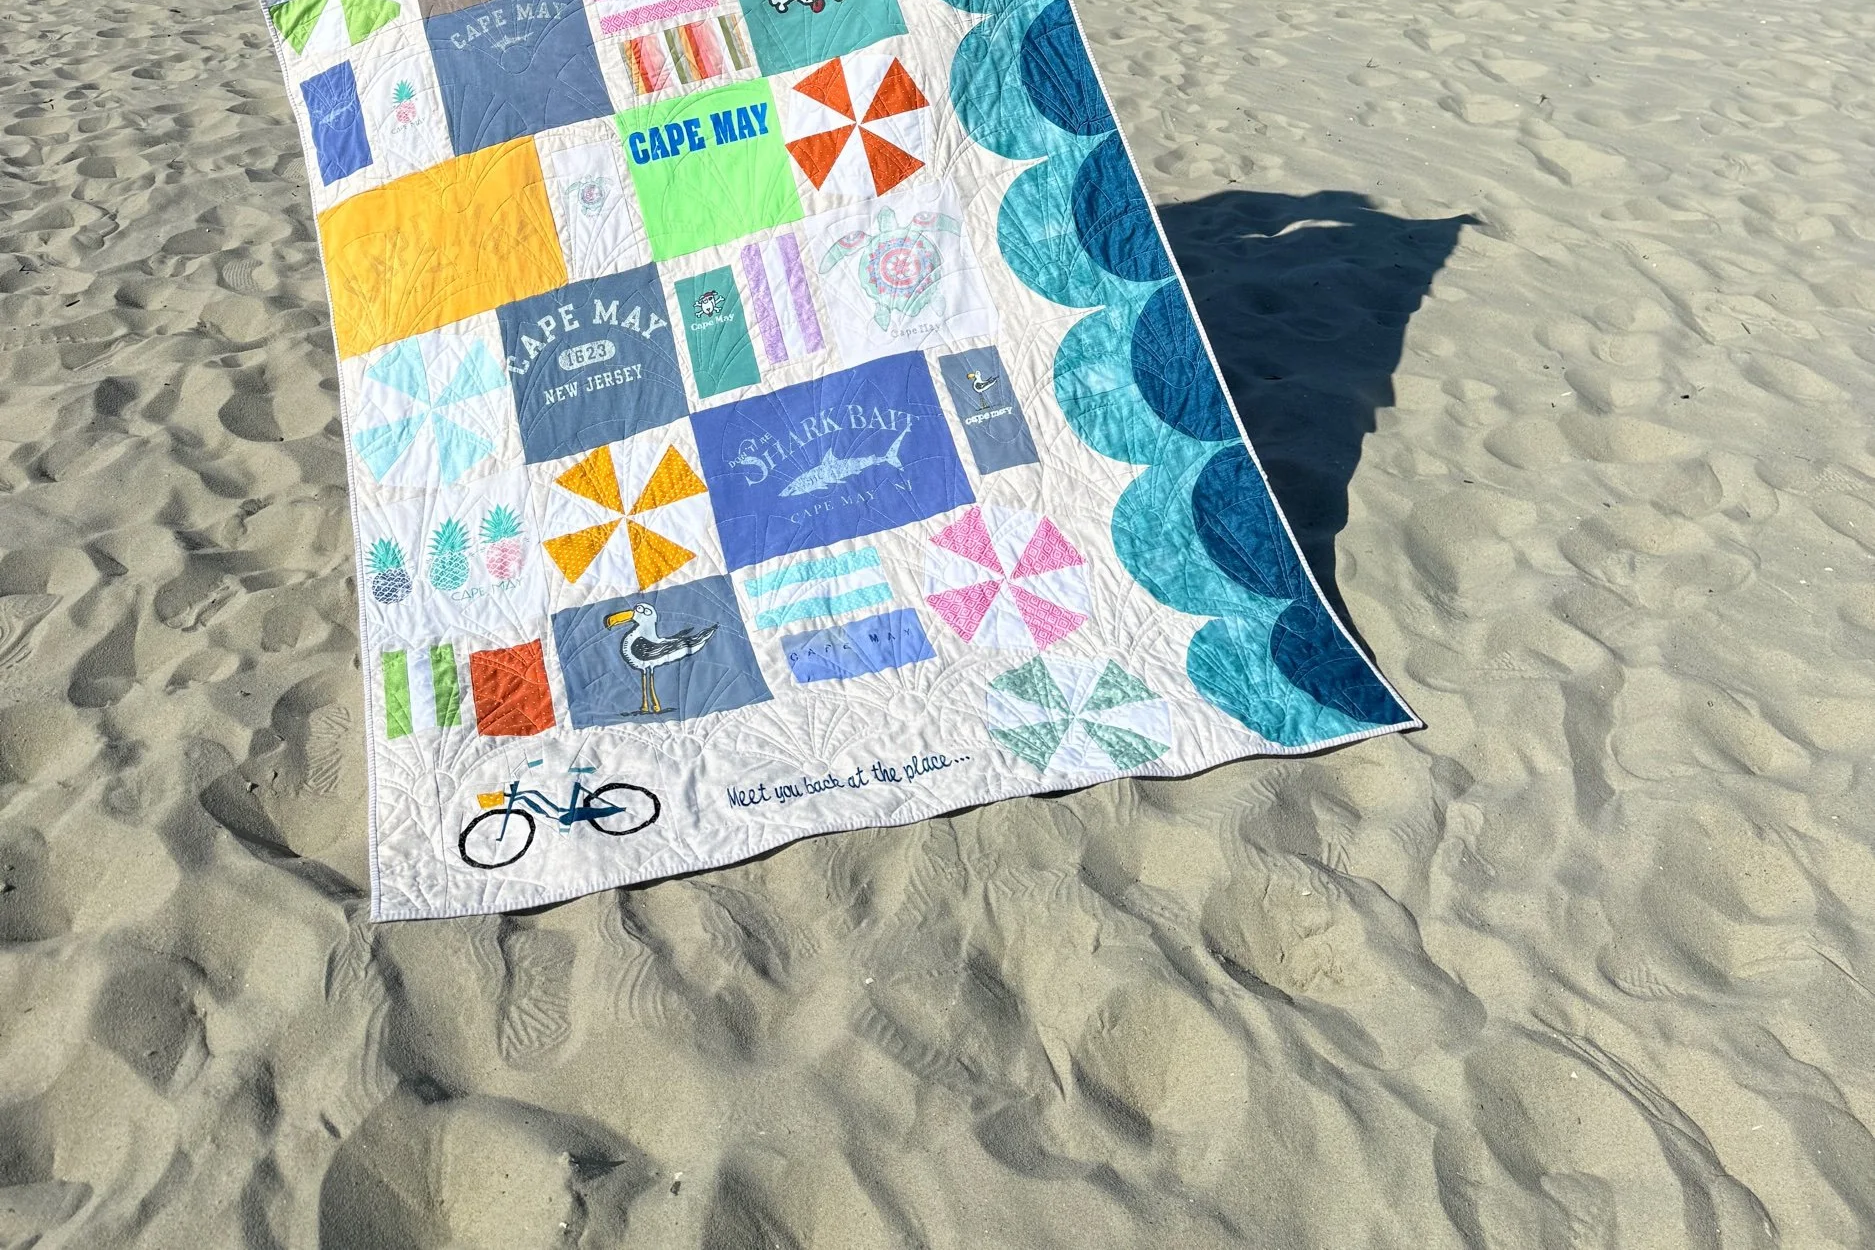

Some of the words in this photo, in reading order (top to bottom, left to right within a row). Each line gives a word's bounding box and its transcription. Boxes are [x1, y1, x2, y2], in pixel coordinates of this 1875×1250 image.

[450, 9, 507, 50] CAPE
[515, 1, 568, 21] MAY
[628, 117, 707, 165] CAPE
[709, 102, 769, 146] MAY
[506, 303, 581, 376] CAPE
[592, 299, 668, 340] MAY
[691, 320, 714, 331] Cape
[715, 313, 735, 323] May
[891, 327, 917, 340] Cape
[566, 343, 607, 367] 1623
[543, 381, 579, 406] NEW
[586, 363, 643, 392] JERSEY
[965, 412, 990, 425] cape
[739, 406, 843, 487] SHARK
[845, 404, 920, 433] BAIT
[790, 500, 834, 524] CAPE
[841, 489, 876, 508] MAY
[894, 479, 913, 492] NJ
[451, 587, 487, 601] CAPE
[491, 578, 523, 594] MAY
[790, 642, 852, 662] CAPE
[868, 628, 910, 643] MAY
[726, 783, 772, 809] Meet
[774, 784, 804, 804] you
[802, 773, 845, 795] back
[847, 767, 869, 788] at
[871, 761, 902, 783] the
[903, 754, 971, 784] place...
